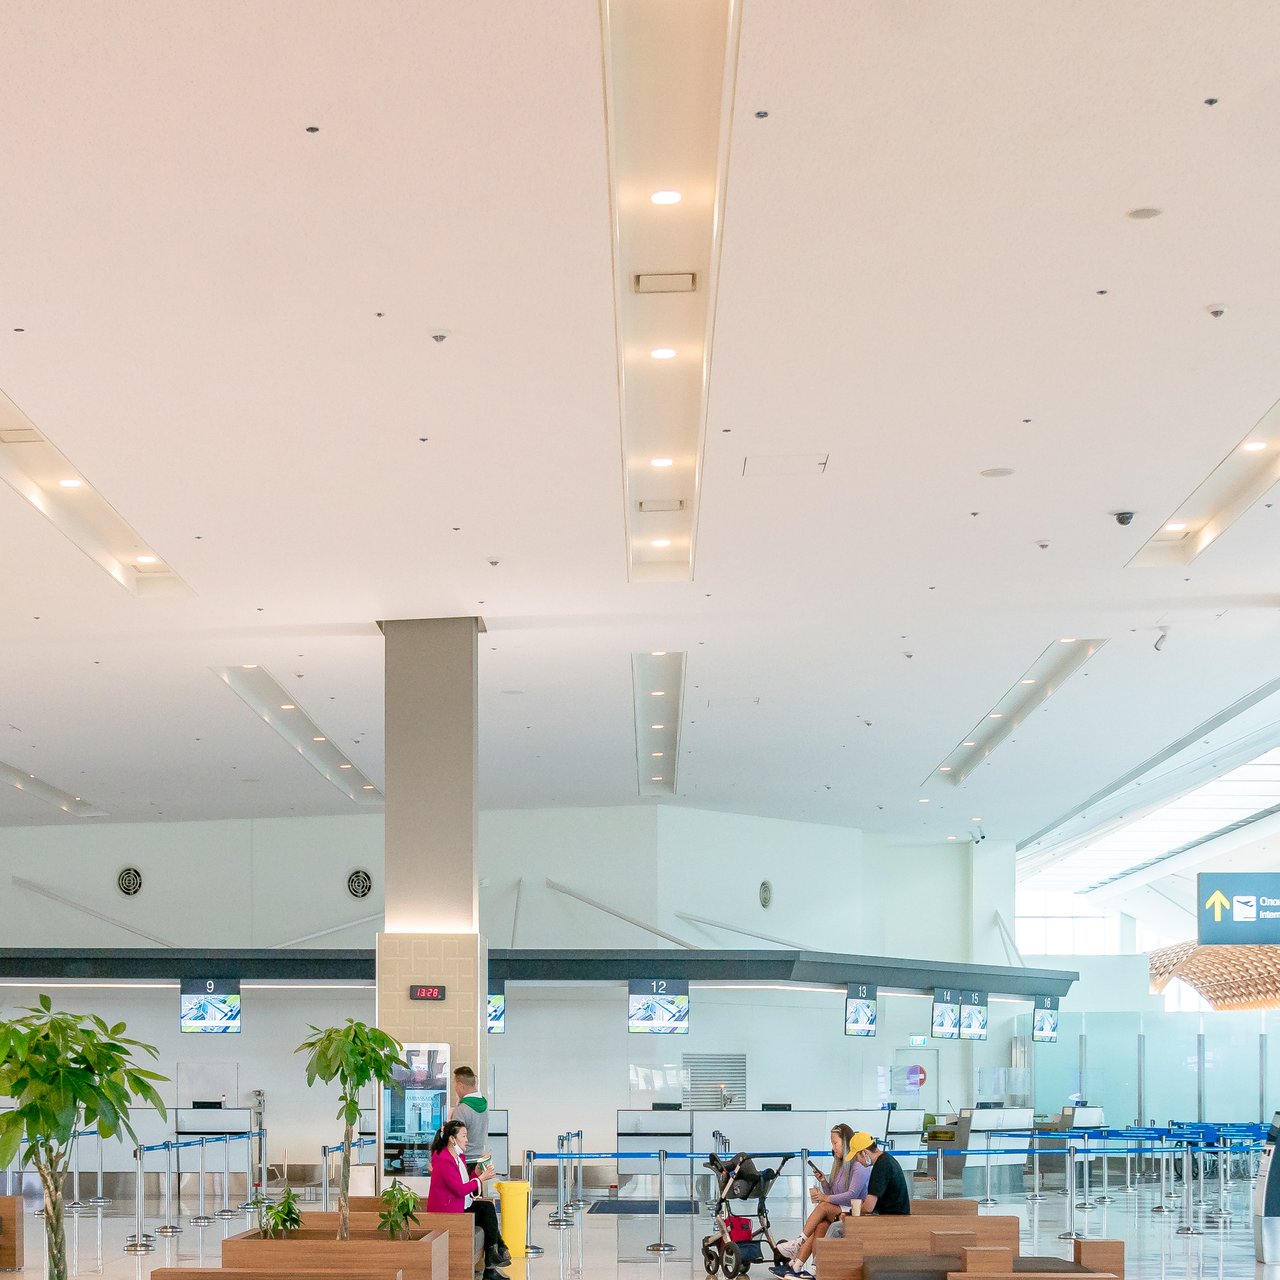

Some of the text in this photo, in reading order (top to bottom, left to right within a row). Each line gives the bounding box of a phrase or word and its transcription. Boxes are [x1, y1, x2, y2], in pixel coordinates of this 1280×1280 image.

[206, 980, 215, 993] 9
[651, 980, 667, 994] 12
[858, 985, 867, 998] 13
[943, 990, 951, 1002] 14
[971, 992, 979, 1005] 15
[1044, 997, 1051, 1008] 16
